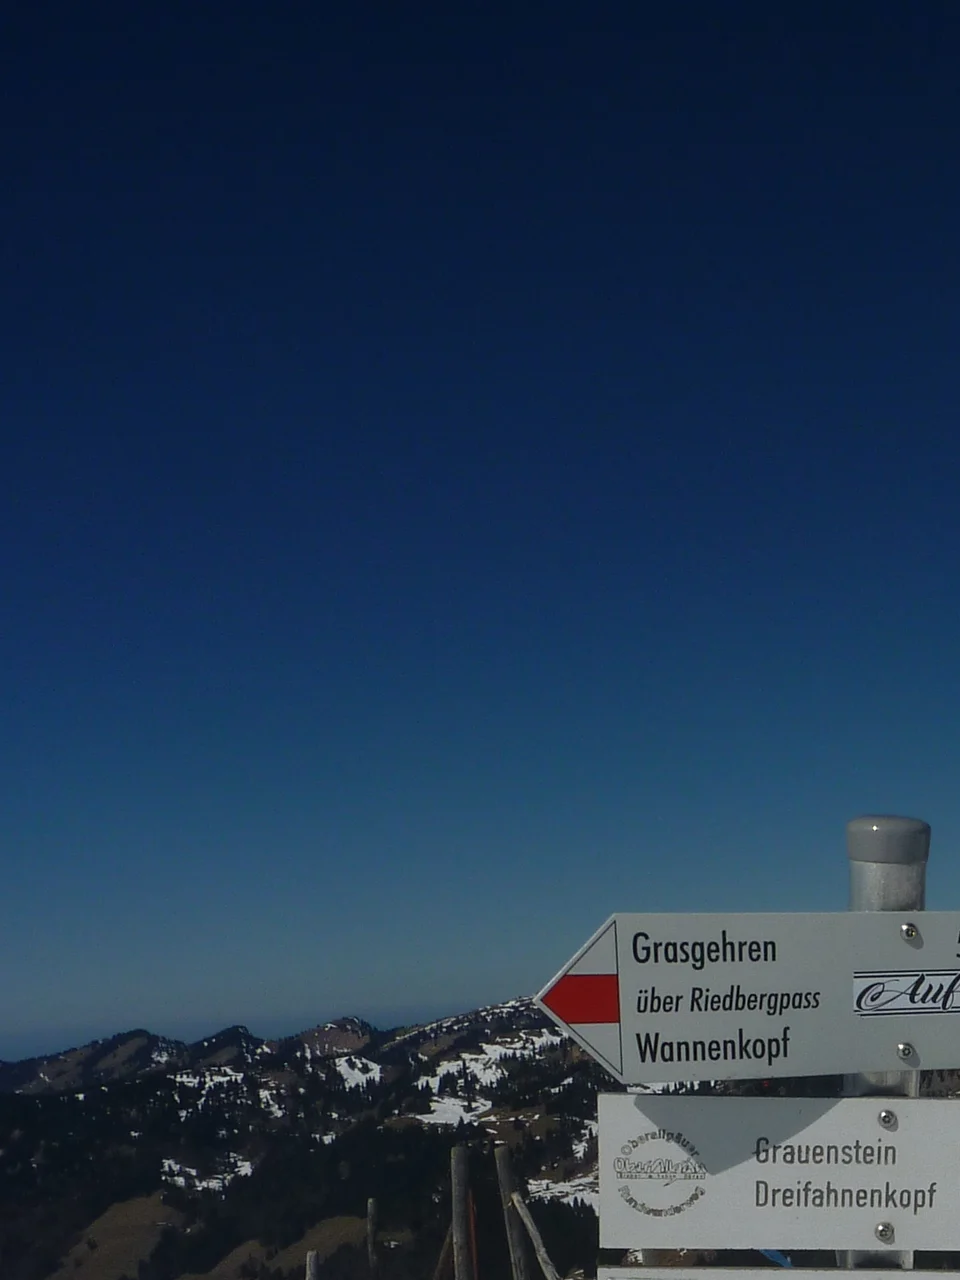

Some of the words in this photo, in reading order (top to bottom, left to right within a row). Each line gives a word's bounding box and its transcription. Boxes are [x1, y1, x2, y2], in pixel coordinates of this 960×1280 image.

[632, 930, 777, 971] Grasgehren
[636, 986, 684, 1014] über
[690, 984, 821, 1016] Riedbergpass
[636, 1026, 790, 1066] Wannenkopf
[754, 1136, 897, 1166] Grauenstein
[755, 1180, 937, 1215] Dreifahnenkopf
